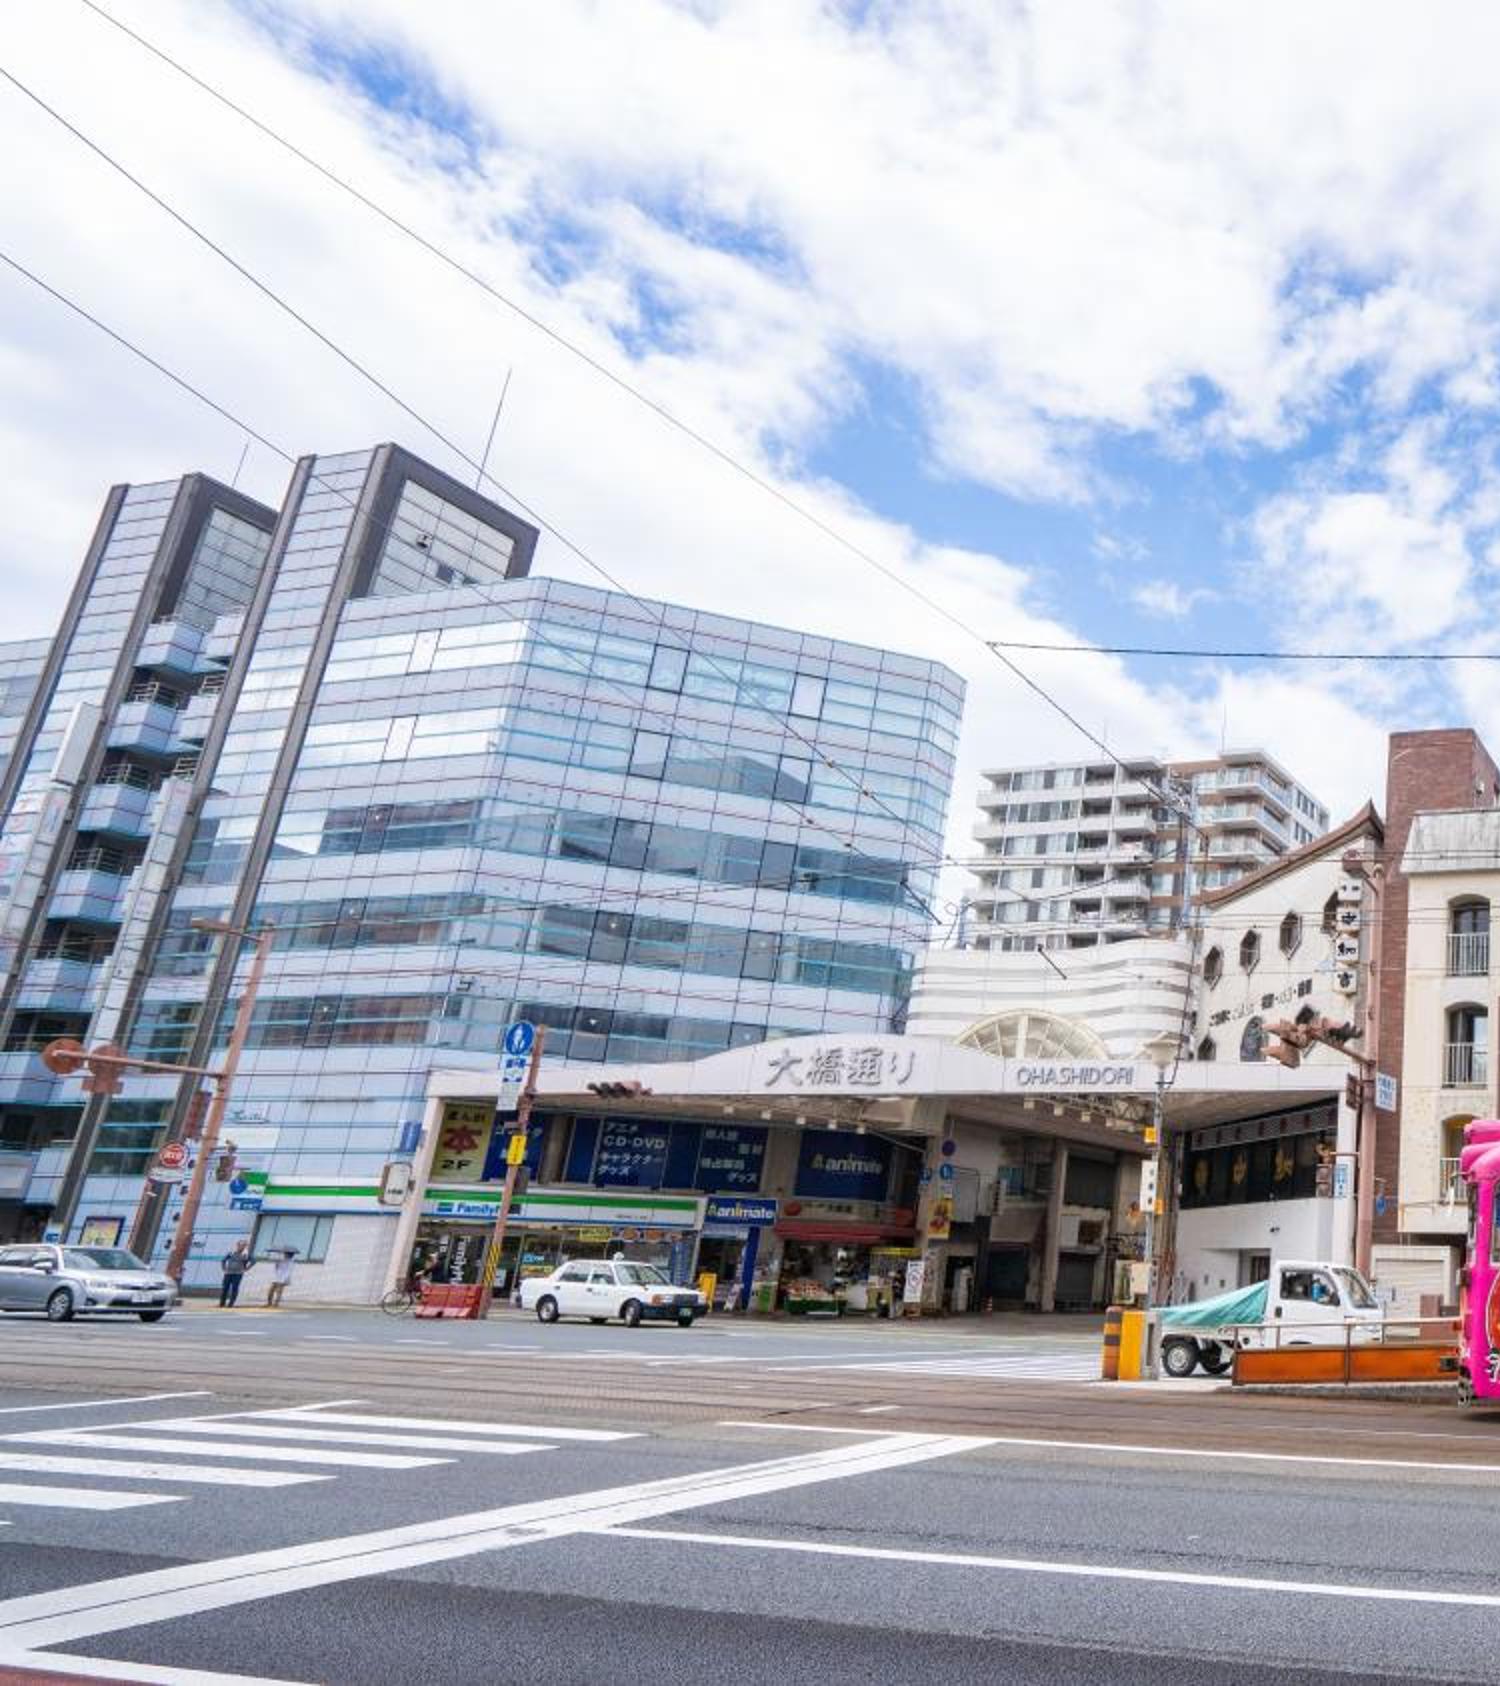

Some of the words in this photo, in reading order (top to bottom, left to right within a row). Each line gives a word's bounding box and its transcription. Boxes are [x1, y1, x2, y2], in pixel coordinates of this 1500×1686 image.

[765, 1046, 918, 1087] 大橋通り
[1017, 1066, 1134, 1087] OHASHIDORI
[441, 1159, 473, 1169] 2F
[717, 1202, 775, 1219] animate
